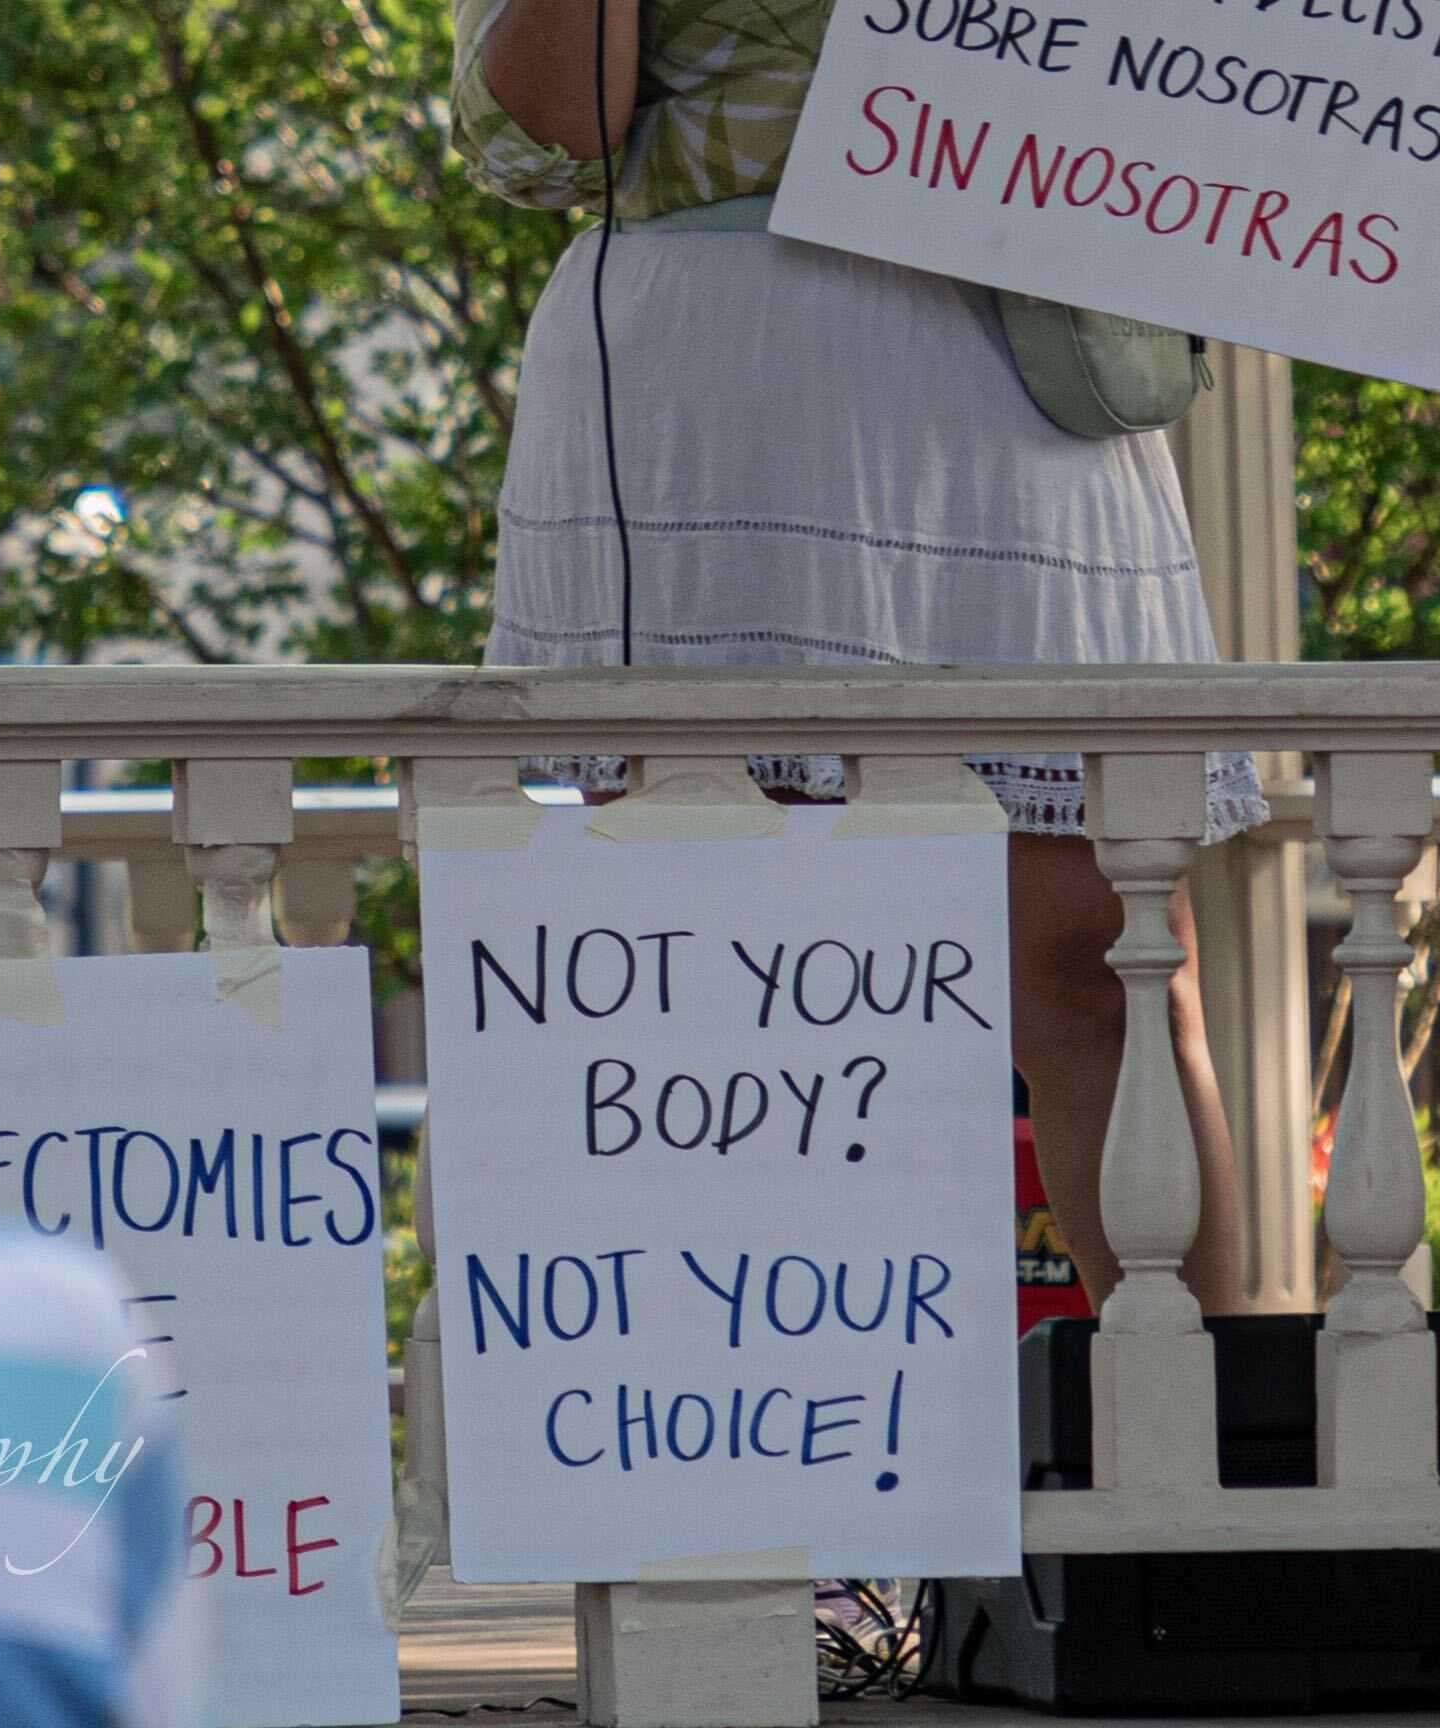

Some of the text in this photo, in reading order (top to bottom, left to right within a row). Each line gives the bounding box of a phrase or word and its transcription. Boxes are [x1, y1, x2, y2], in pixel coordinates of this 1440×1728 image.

[845, 85, 1399, 285] SIN NOSOTRAS
[471, 925, 992, 1032] NOT YOUR
[586, 1055, 887, 1163] BODY?
[467, 1250, 955, 1354] NOT YOUR
[546, 1370, 904, 1492] CHOICE!
